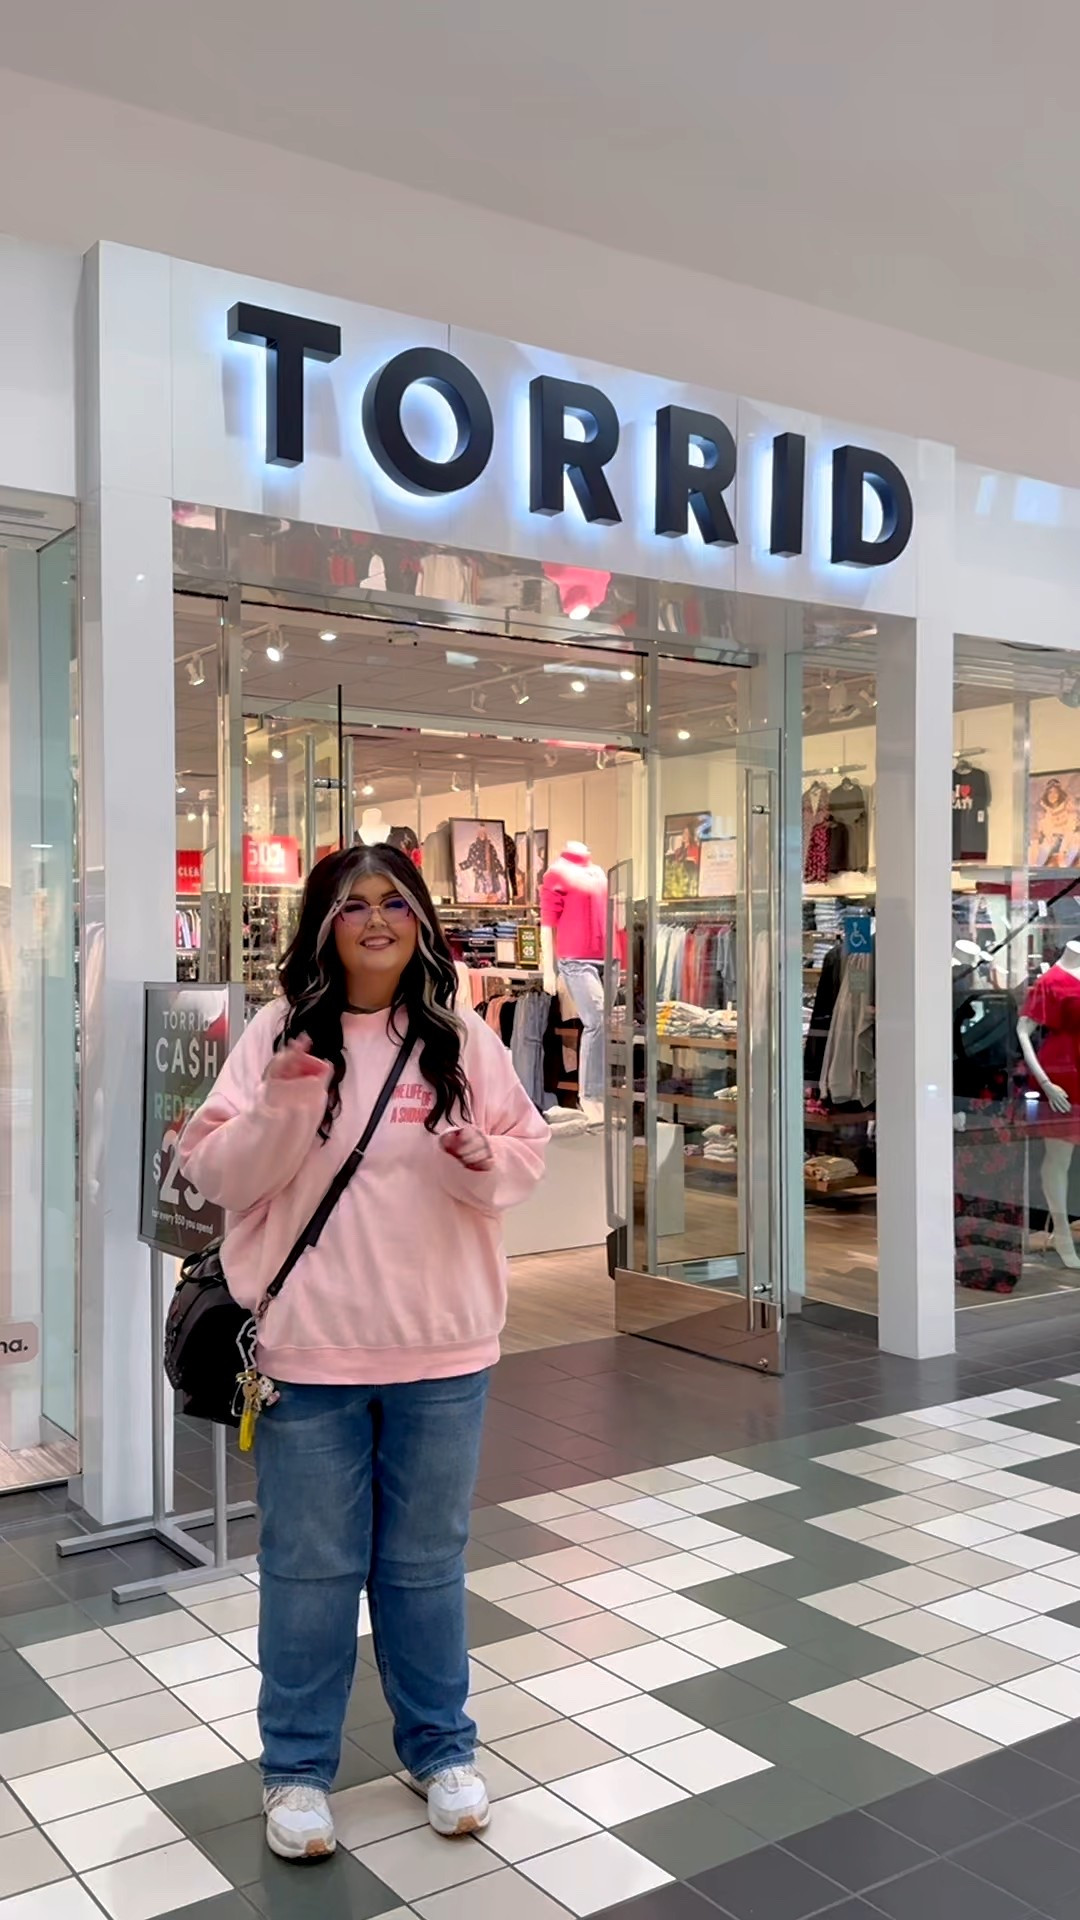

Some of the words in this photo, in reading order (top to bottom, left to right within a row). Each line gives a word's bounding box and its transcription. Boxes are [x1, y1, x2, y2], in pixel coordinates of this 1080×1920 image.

[227, 301, 914, 569] TORRID
[162, 1010, 210, 1032] TORRID
[390, 1107, 397, 1123] A
